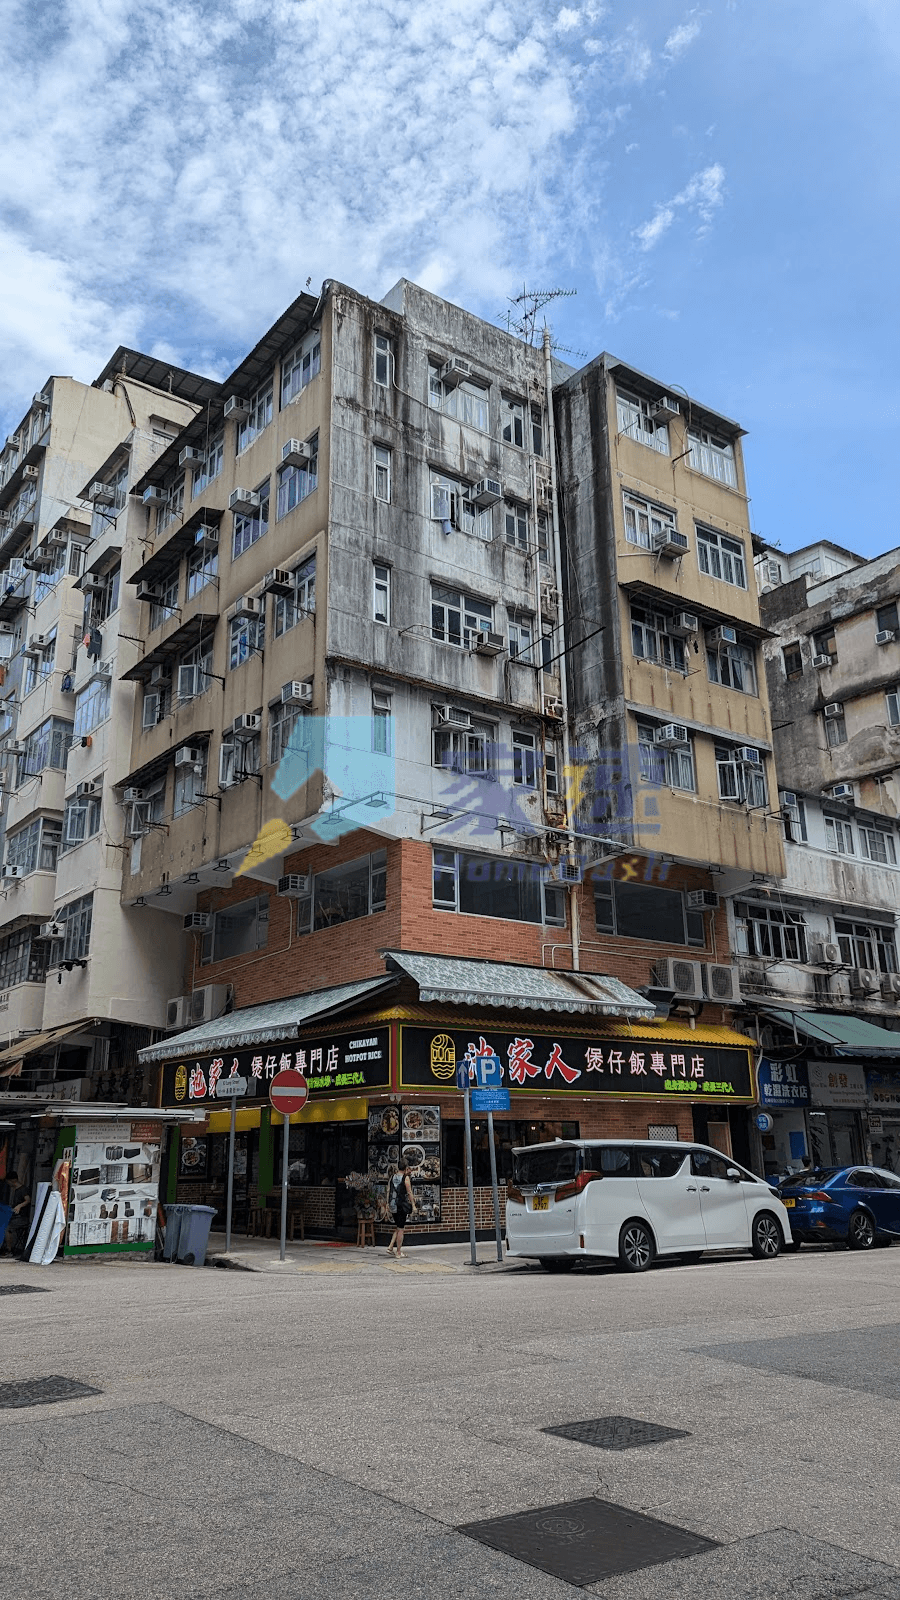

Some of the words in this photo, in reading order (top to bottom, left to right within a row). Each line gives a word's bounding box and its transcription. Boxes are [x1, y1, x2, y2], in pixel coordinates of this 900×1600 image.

[348, 1037, 379, 1050] CHIKAYAN
[250, 1045, 340, 1079] 煲仔飯專門店
[344, 1051, 368, 1064] HOTPOT
[367, 1050, 382, 1061] RICE
[584, 1046, 705, 1079] 煲仔飯專門店
[481, 1058, 496, 1084] P
[769, 1062, 799, 1083] 彩虹
